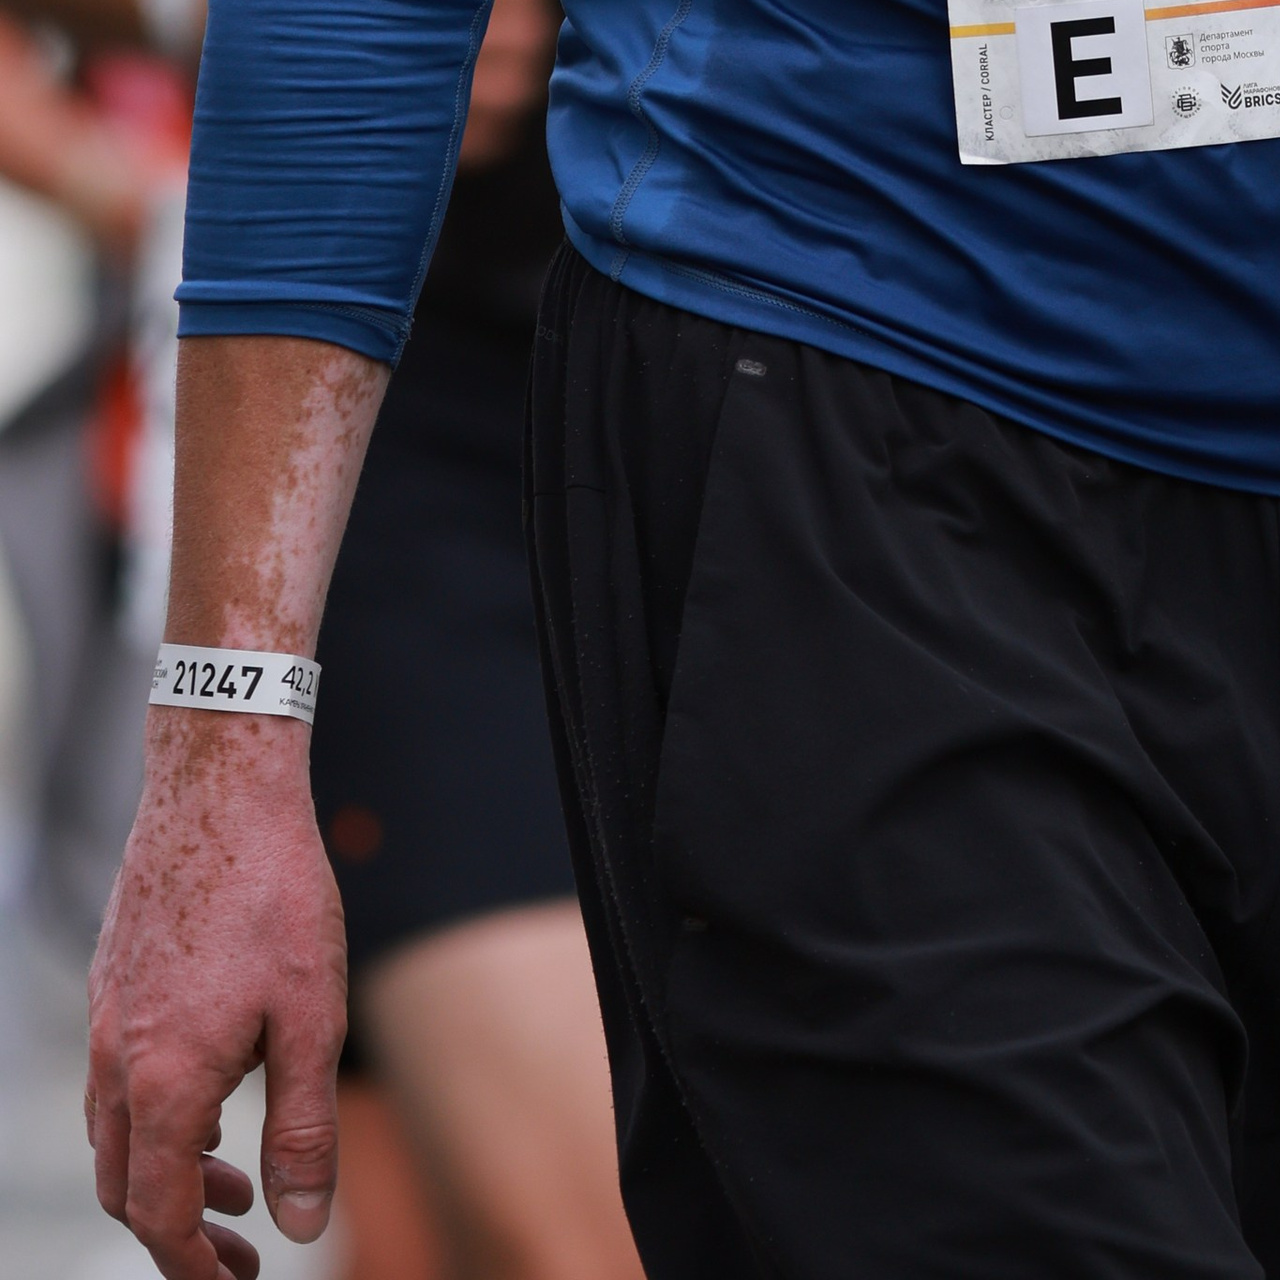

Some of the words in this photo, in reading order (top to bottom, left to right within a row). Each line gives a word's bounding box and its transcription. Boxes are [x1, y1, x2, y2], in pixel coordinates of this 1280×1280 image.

[1200, 29, 1253, 42] Департамент
[1200, 42, 1230, 53] спорта
[979, 43, 990, 85] CORRAL
[1050, 16, 1123, 121] E
[1201, 54, 1232, 64] города
[1233, 50, 1265, 60] Москвы
[982, 94, 995, 141] КЛАСТЕР
[173, 660, 264, 700] 21247
[281, 665, 313, 697] 42,2
